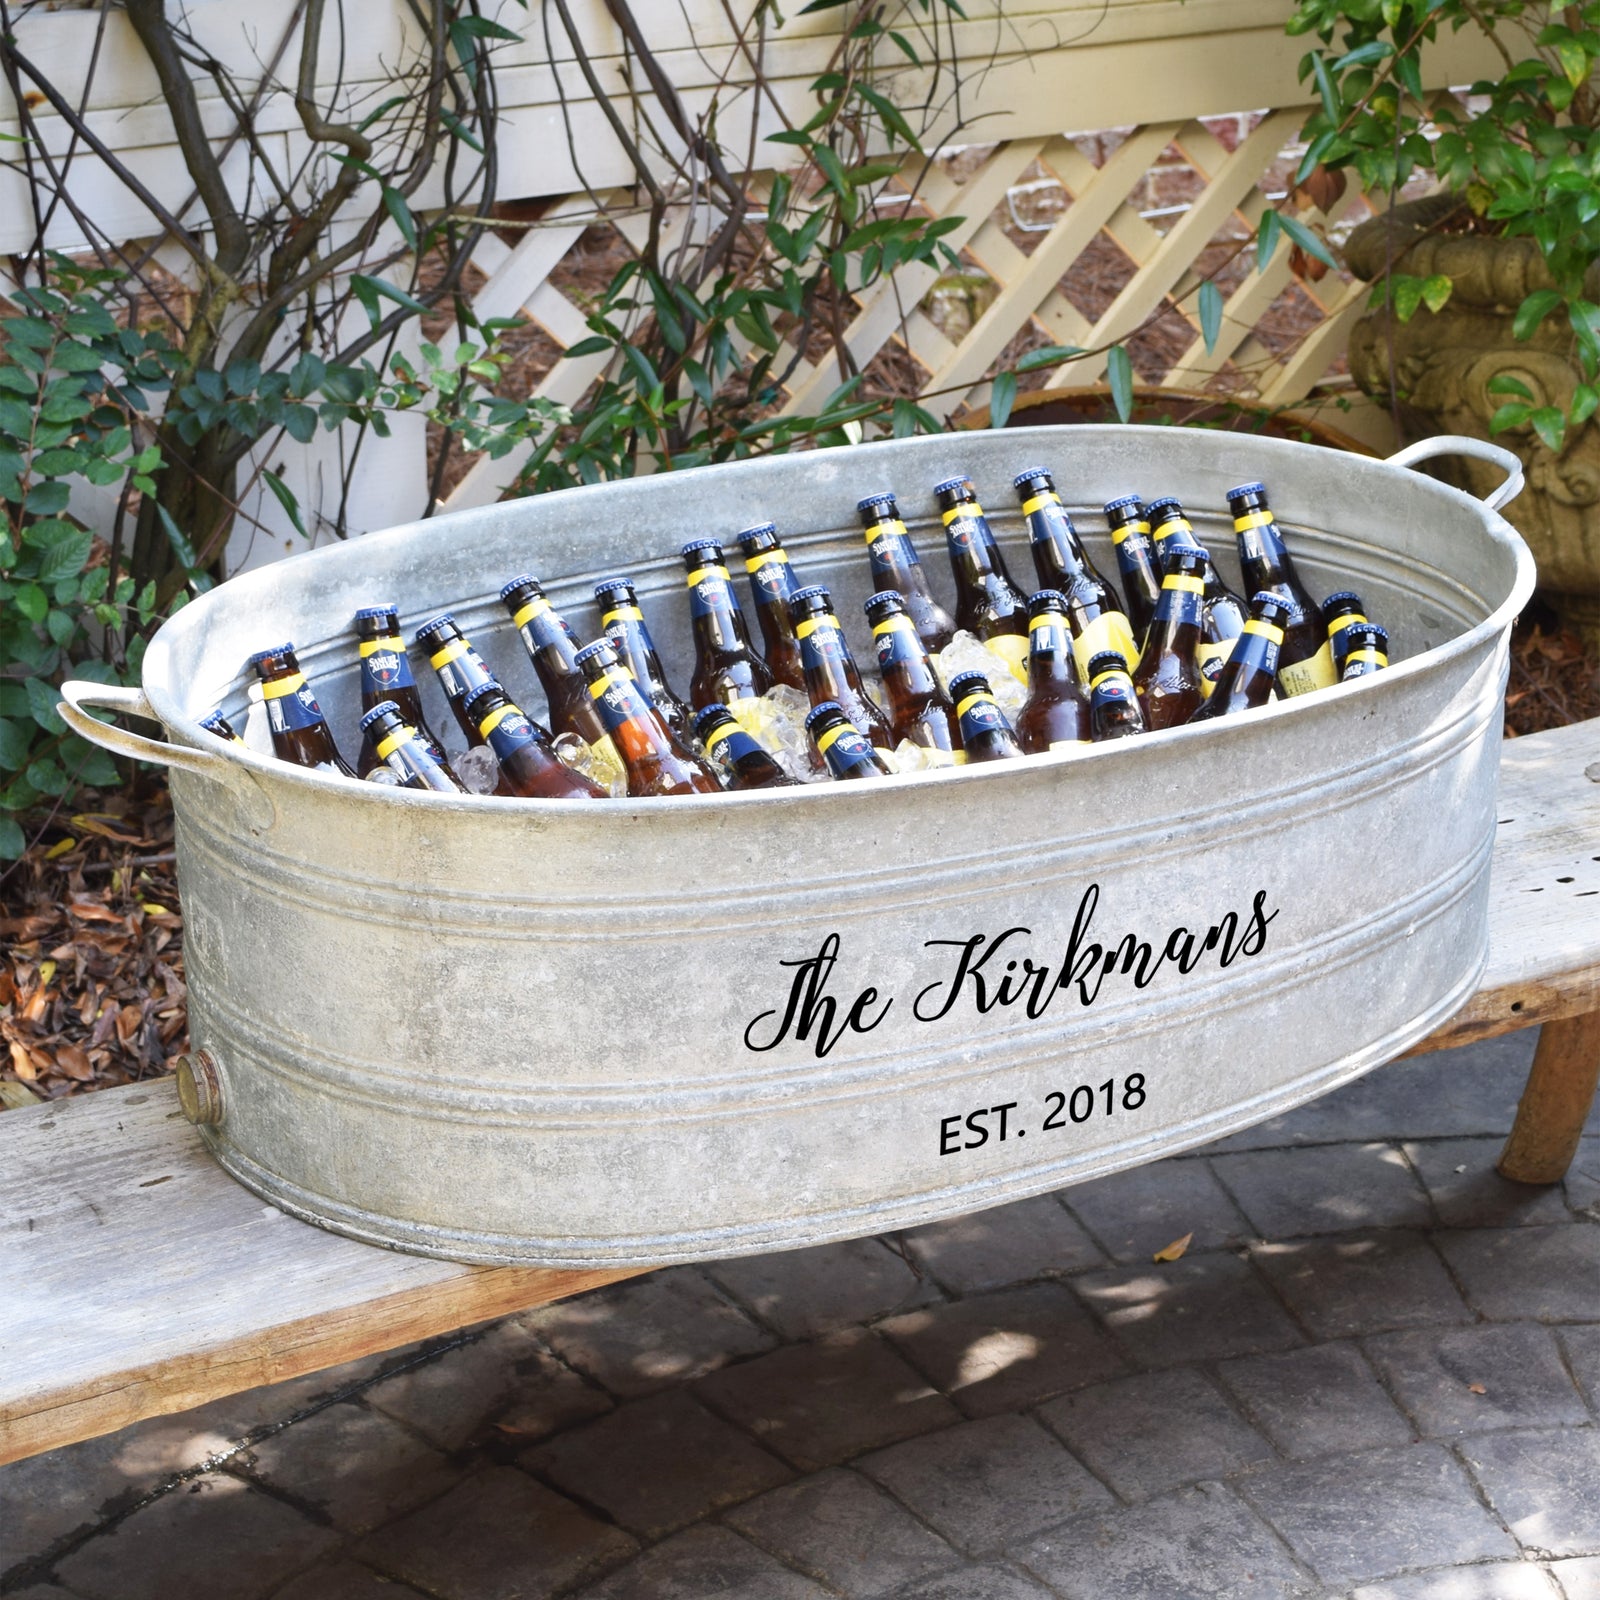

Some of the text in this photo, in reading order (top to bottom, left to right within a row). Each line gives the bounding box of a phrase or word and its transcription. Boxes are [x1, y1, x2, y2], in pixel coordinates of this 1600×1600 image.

[743, 883, 1280, 1059] The Kirkmans
[939, 1072, 1146, 1156] EST. 2018
